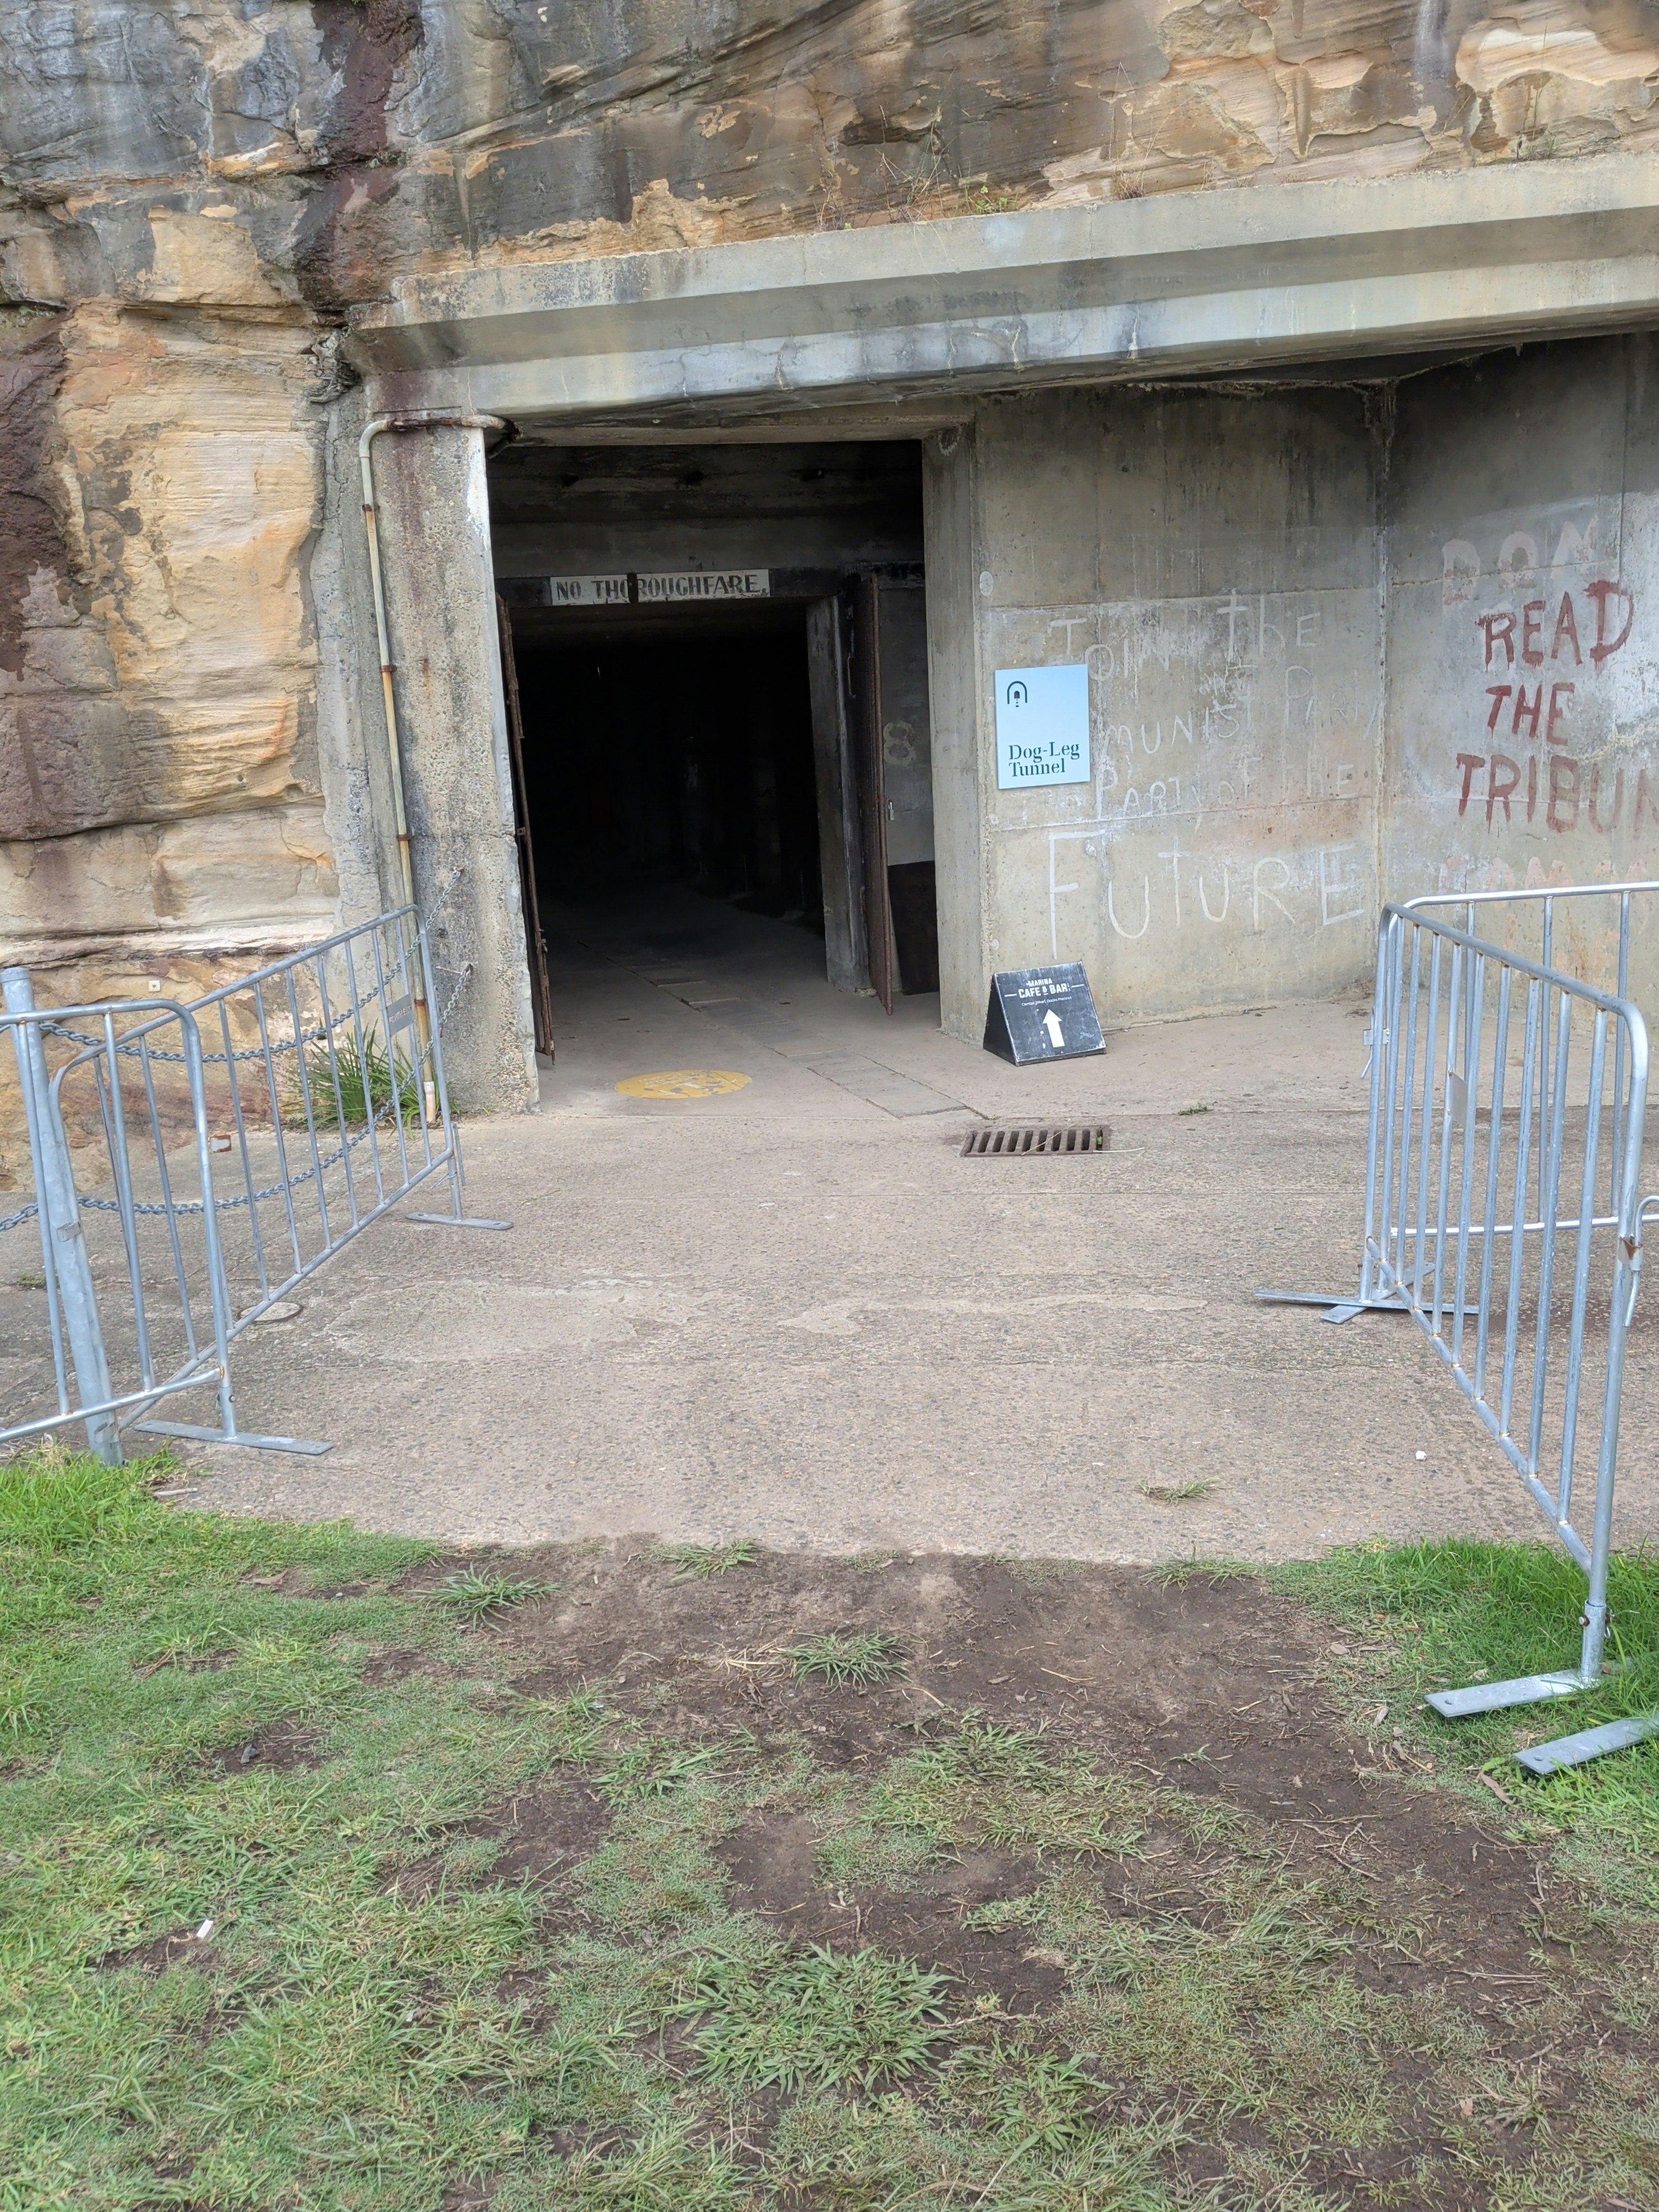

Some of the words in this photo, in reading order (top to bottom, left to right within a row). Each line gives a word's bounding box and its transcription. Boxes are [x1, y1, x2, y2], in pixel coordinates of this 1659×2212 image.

[556, 581, 581, 601] NO
[1475, 580, 1634, 667] READ
[1486, 682, 1575, 746] THE
[1009, 742, 1080, 763] Dog-Leg
[1009, 758, 1066, 777] Tunnel
[1018, 988, 1041, 998] CAFE
[1050, 983, 1068, 994] BAR
[1026, 978, 1052, 987] MARINA
